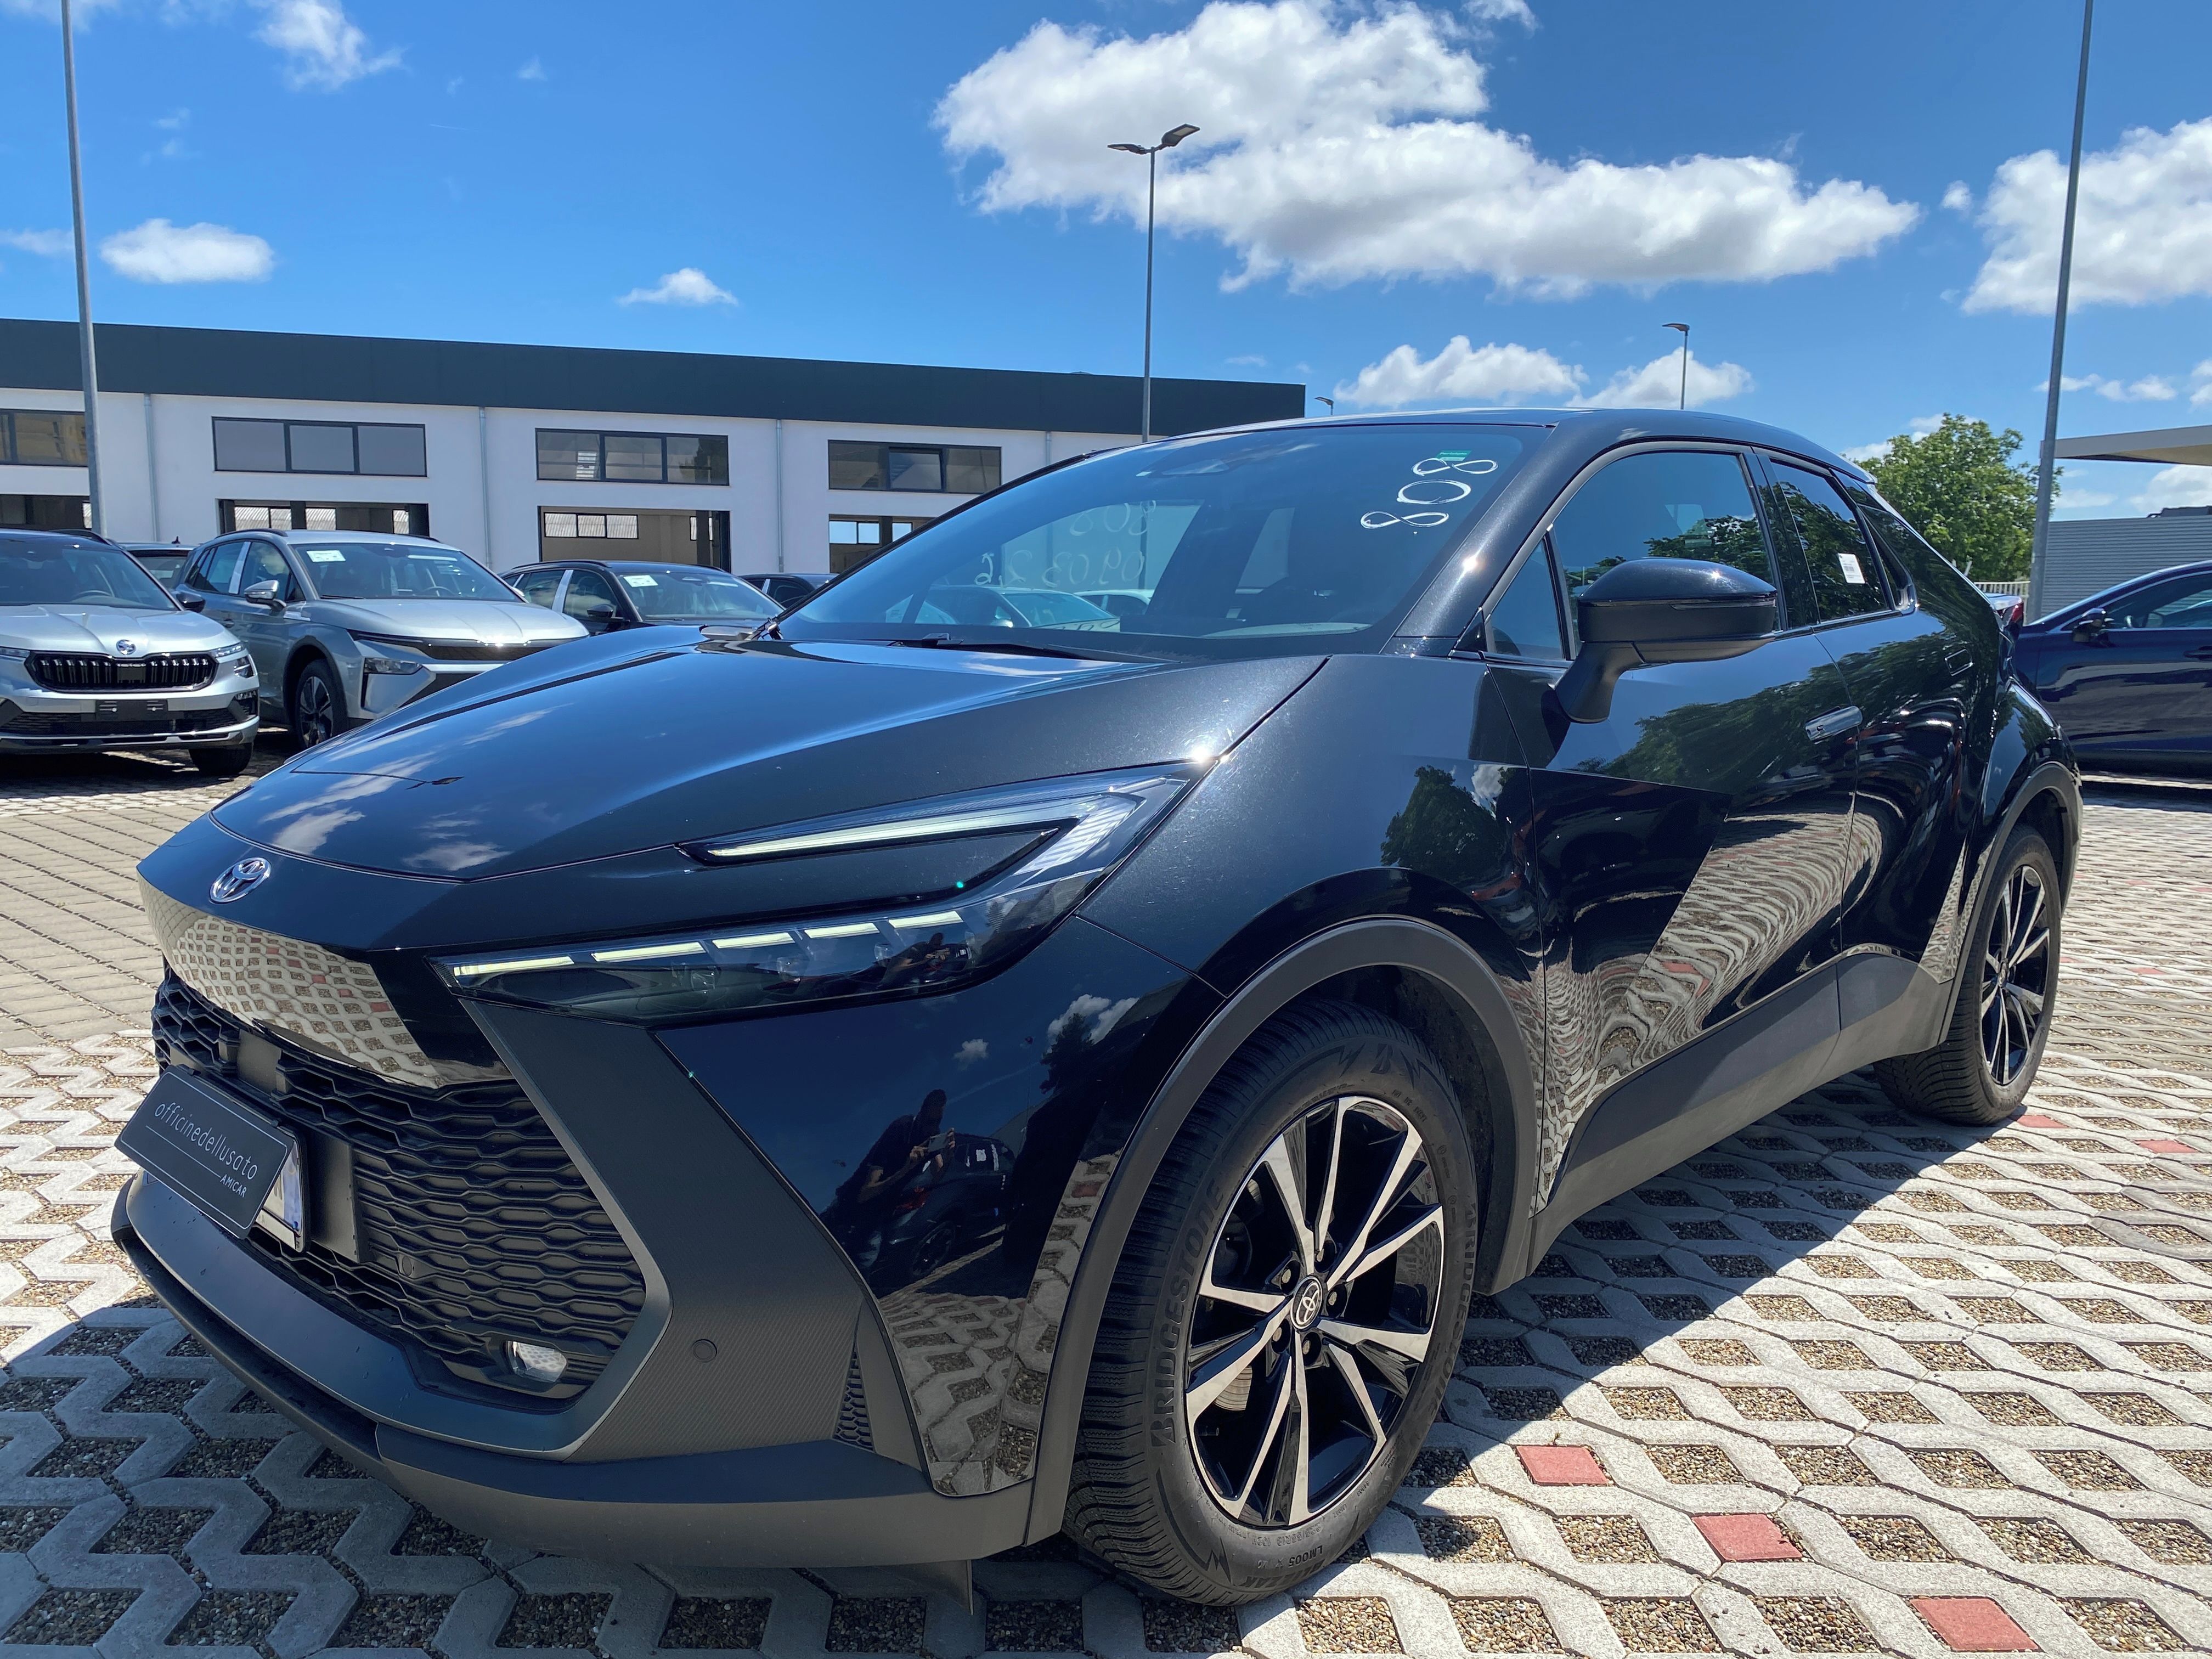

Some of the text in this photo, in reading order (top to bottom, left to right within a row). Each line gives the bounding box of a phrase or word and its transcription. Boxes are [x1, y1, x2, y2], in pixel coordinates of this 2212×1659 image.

[1360, 457, 1499, 529] 808
[155, 1102, 257, 1180] officinedellusato
[220, 1174, 247, 1198] AMICAR
[1152, 1178, 1224, 1448] BRIDGESTONE
[1288, 1545, 1323, 1568] LM005
